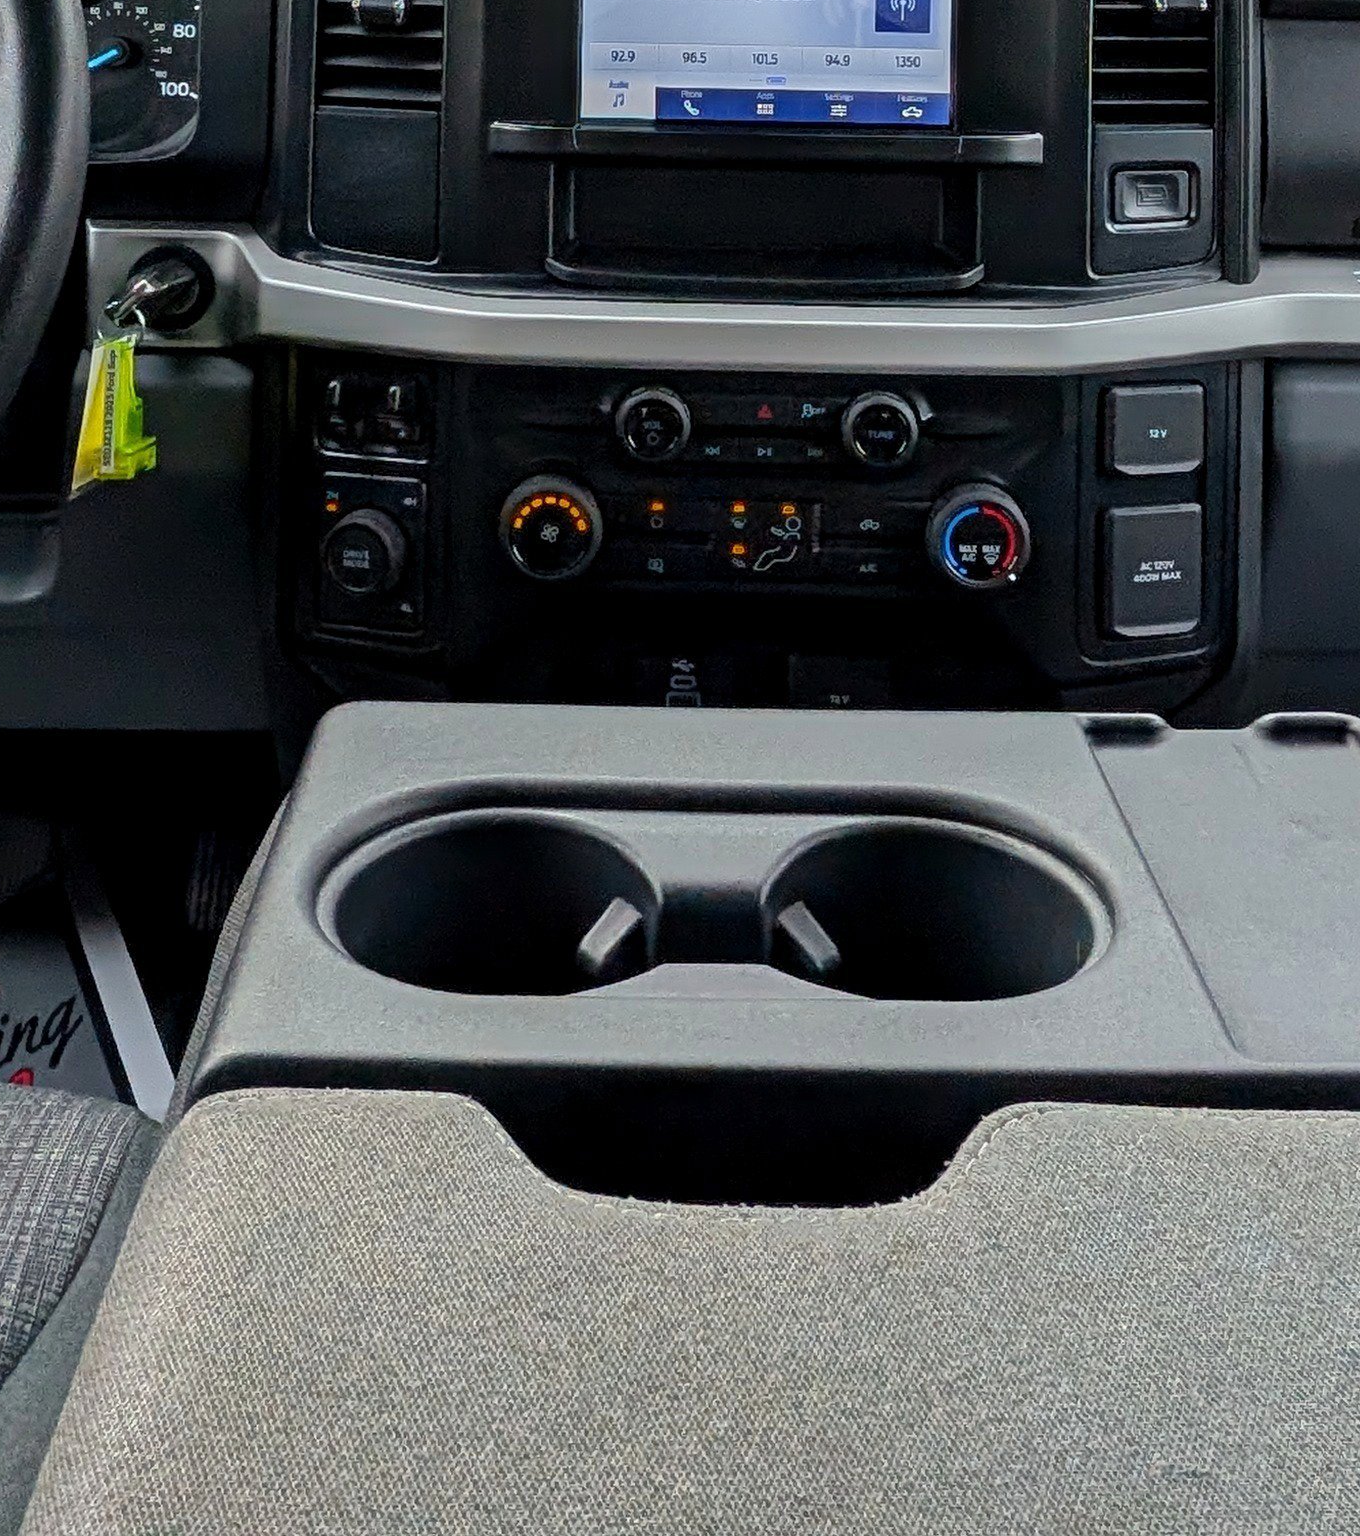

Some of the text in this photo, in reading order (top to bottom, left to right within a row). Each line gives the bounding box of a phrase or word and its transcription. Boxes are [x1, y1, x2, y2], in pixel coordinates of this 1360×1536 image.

[172, 24, 196, 38] 80
[611, 50, 636, 63] 92.9
[682, 51, 707, 64] 96.5
[825, 54, 851, 67] 94.9
[895, 55, 921, 68] 1350
[159, 81, 190, 97] 100
